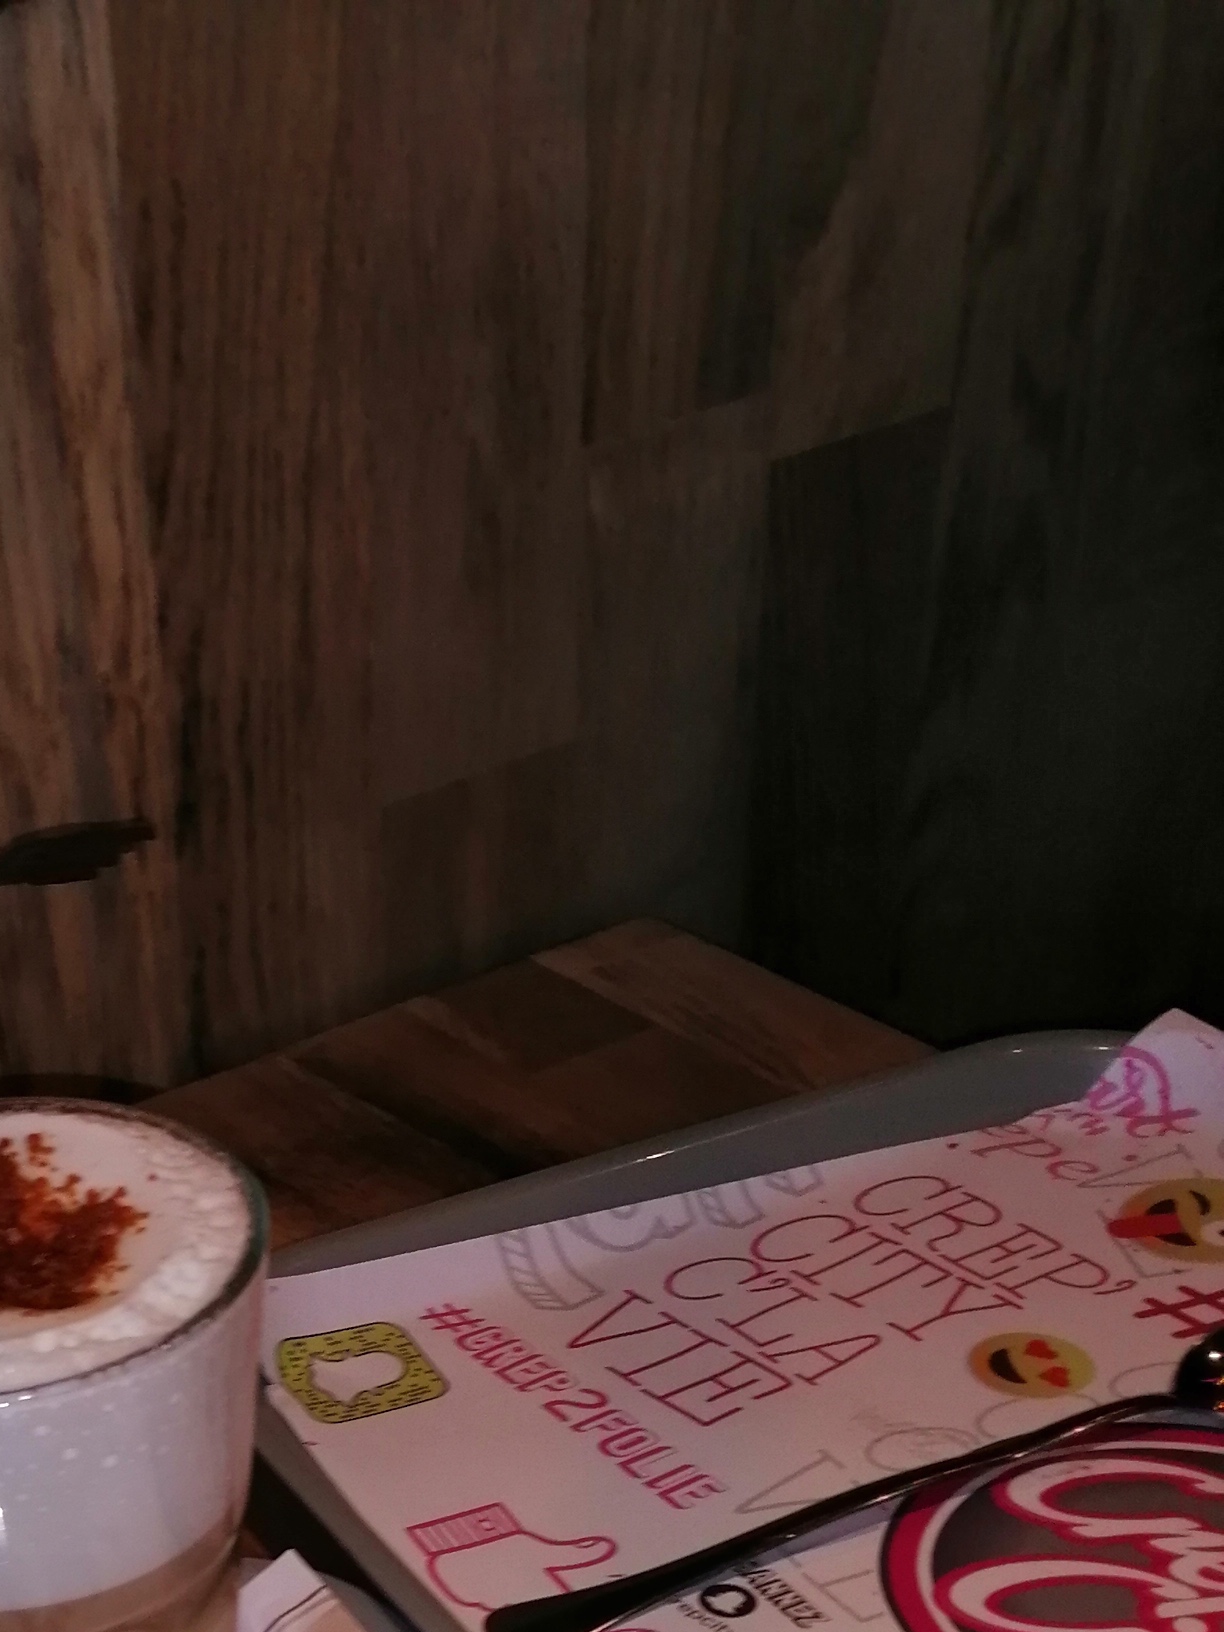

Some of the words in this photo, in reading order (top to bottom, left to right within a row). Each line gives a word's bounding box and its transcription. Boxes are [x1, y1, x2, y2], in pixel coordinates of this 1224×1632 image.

[663, 1256, 882, 1386] C'LA
[750, 1214, 1024, 1341] CITY
[566, 1289, 794, 1427] VIE
